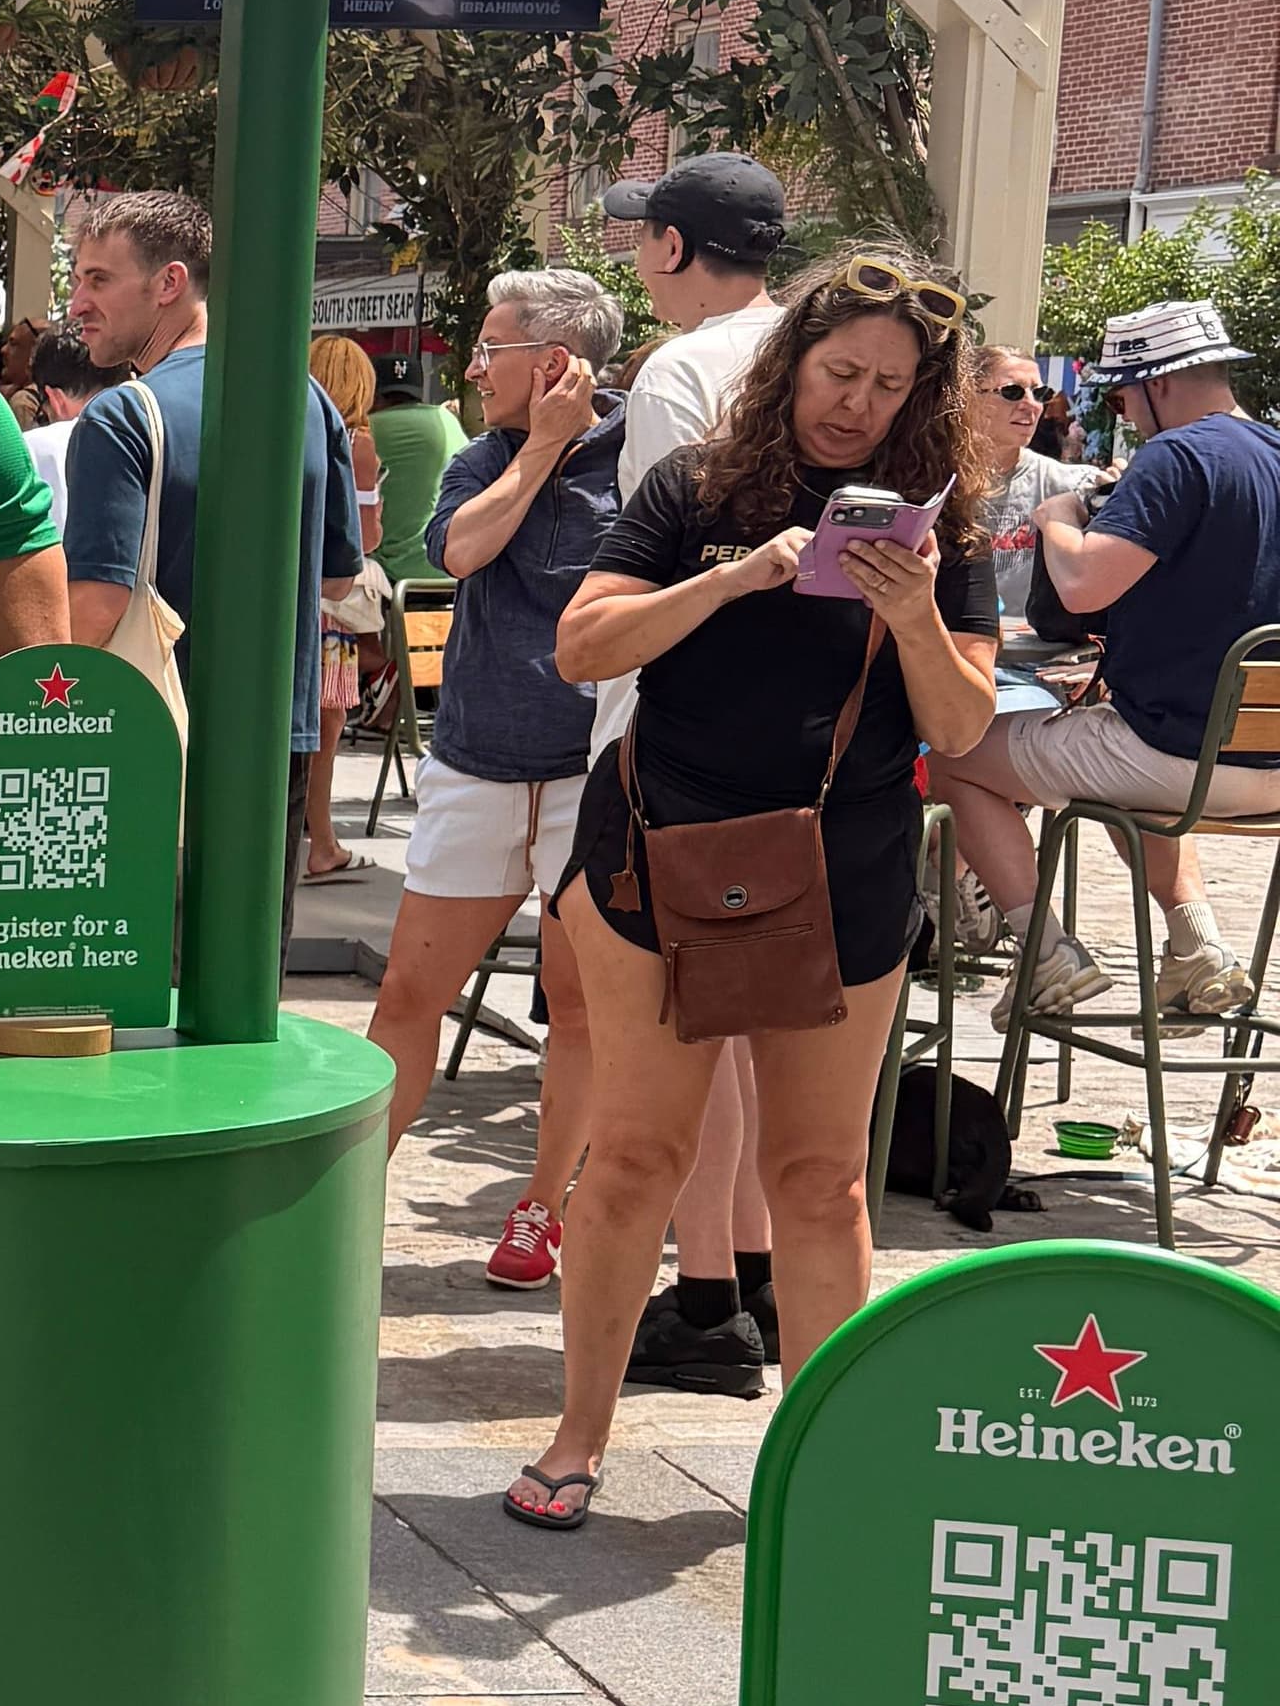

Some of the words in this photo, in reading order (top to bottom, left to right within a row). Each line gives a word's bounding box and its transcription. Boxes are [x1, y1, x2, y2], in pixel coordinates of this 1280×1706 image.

[343, 0, 395, 13] HENRY
[460, 0, 561, 15] IBRAHIMOVIĆ
[312, 297, 344, 324] SOUTH
[347, 295, 385, 323] STREET
[72, 914, 109, 937] for
[114, 918, 128, 935] a
[82, 945, 138, 967] here
[1019, 1387, 1045, 1400] EST.
[1130, 1396, 1158, 1408] 1873
